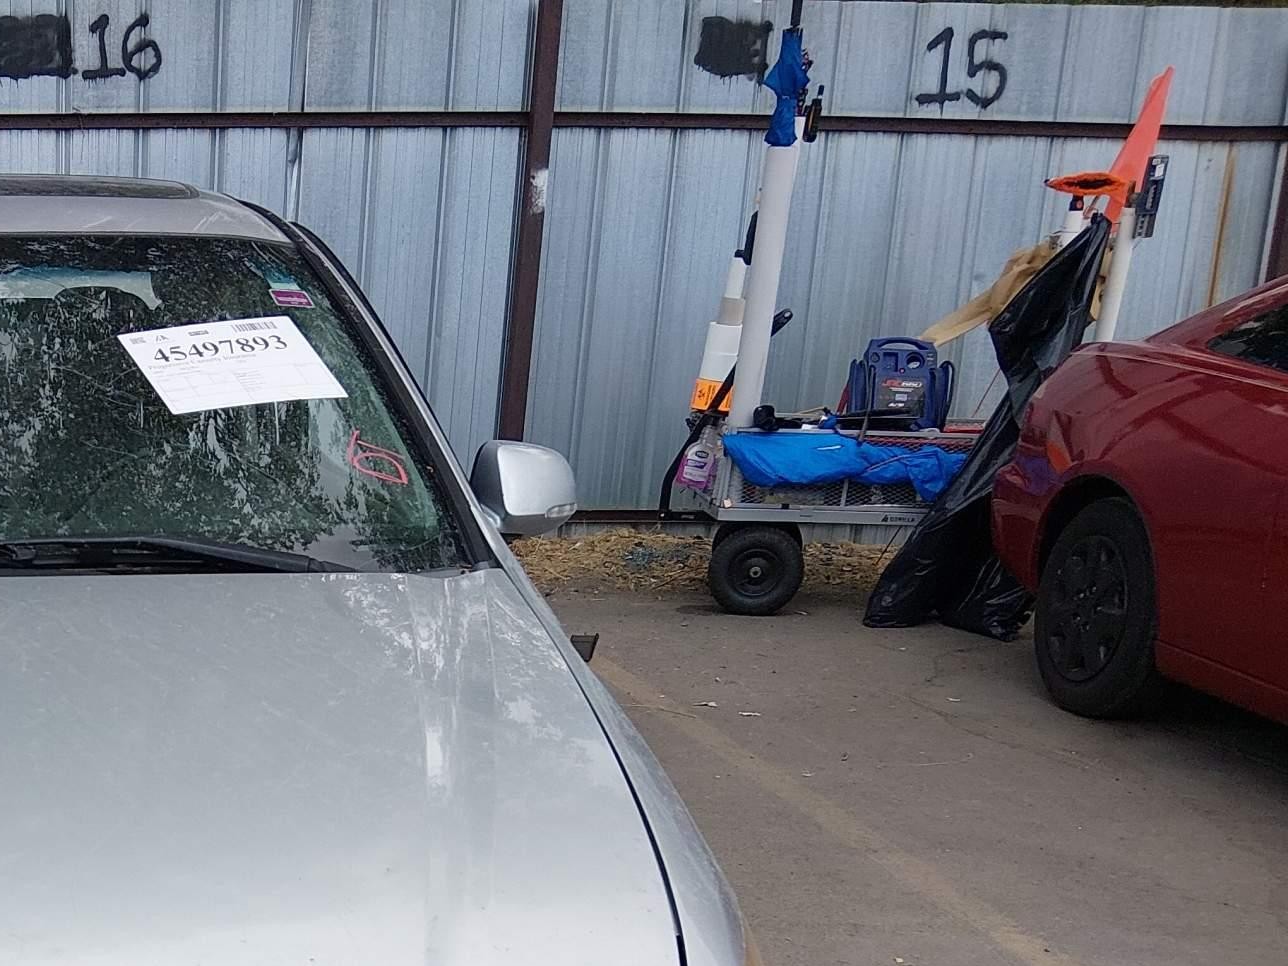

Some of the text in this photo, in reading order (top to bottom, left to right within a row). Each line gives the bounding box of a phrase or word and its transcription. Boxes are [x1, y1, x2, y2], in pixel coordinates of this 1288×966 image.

[81, 13, 162, 82] 16
[915, 26, 1009, 110] 15
[153, 334, 288, 363] 45497893
